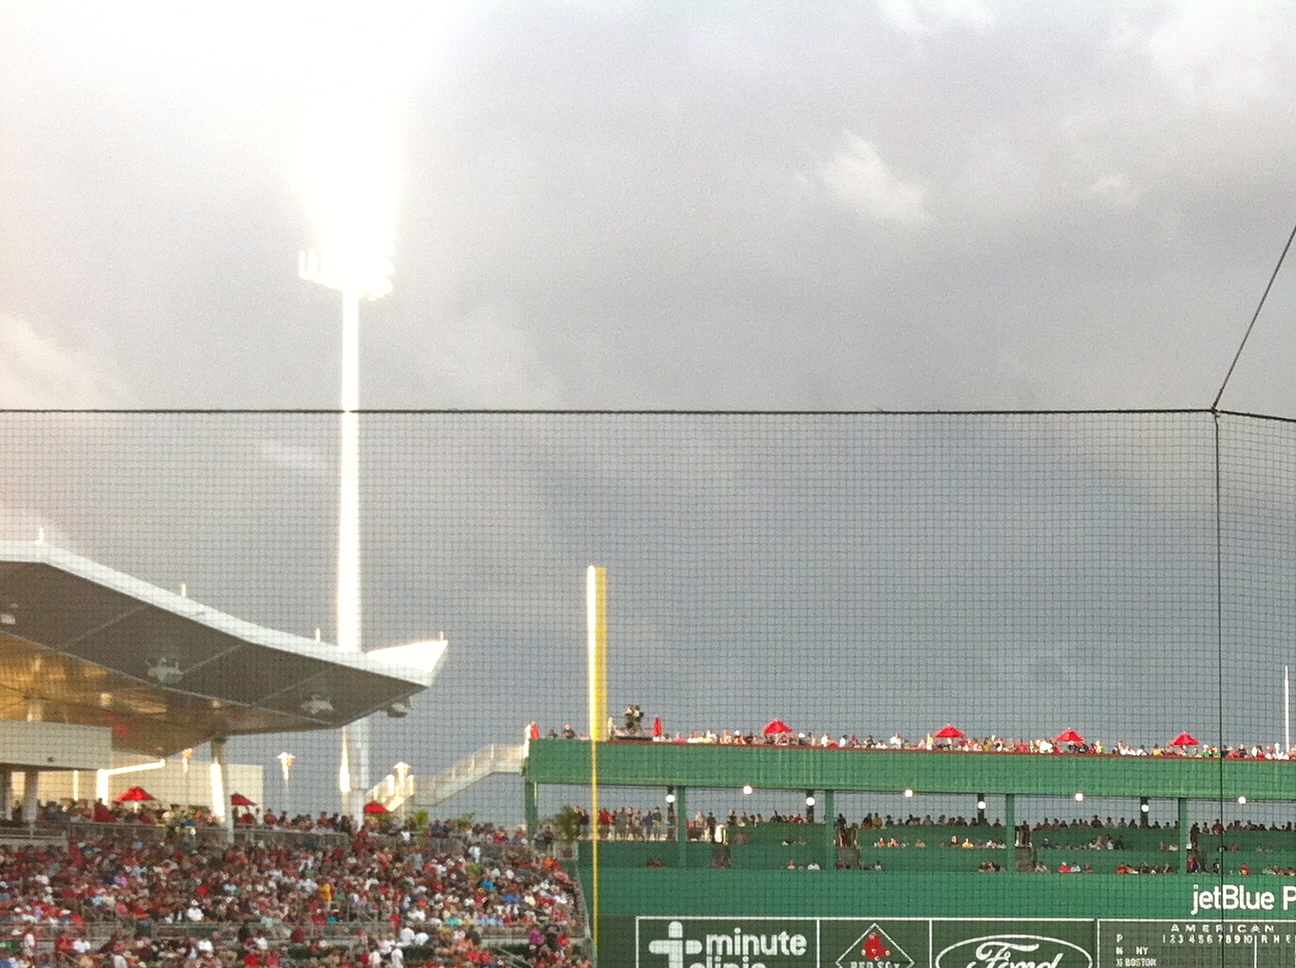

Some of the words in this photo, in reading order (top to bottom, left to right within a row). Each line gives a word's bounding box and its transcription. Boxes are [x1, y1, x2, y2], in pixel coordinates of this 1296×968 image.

[1191, 884, 1275, 915] jetBlue
[706, 927, 807, 956] minute
[1171, 924, 1274, 934] AMERICAN
